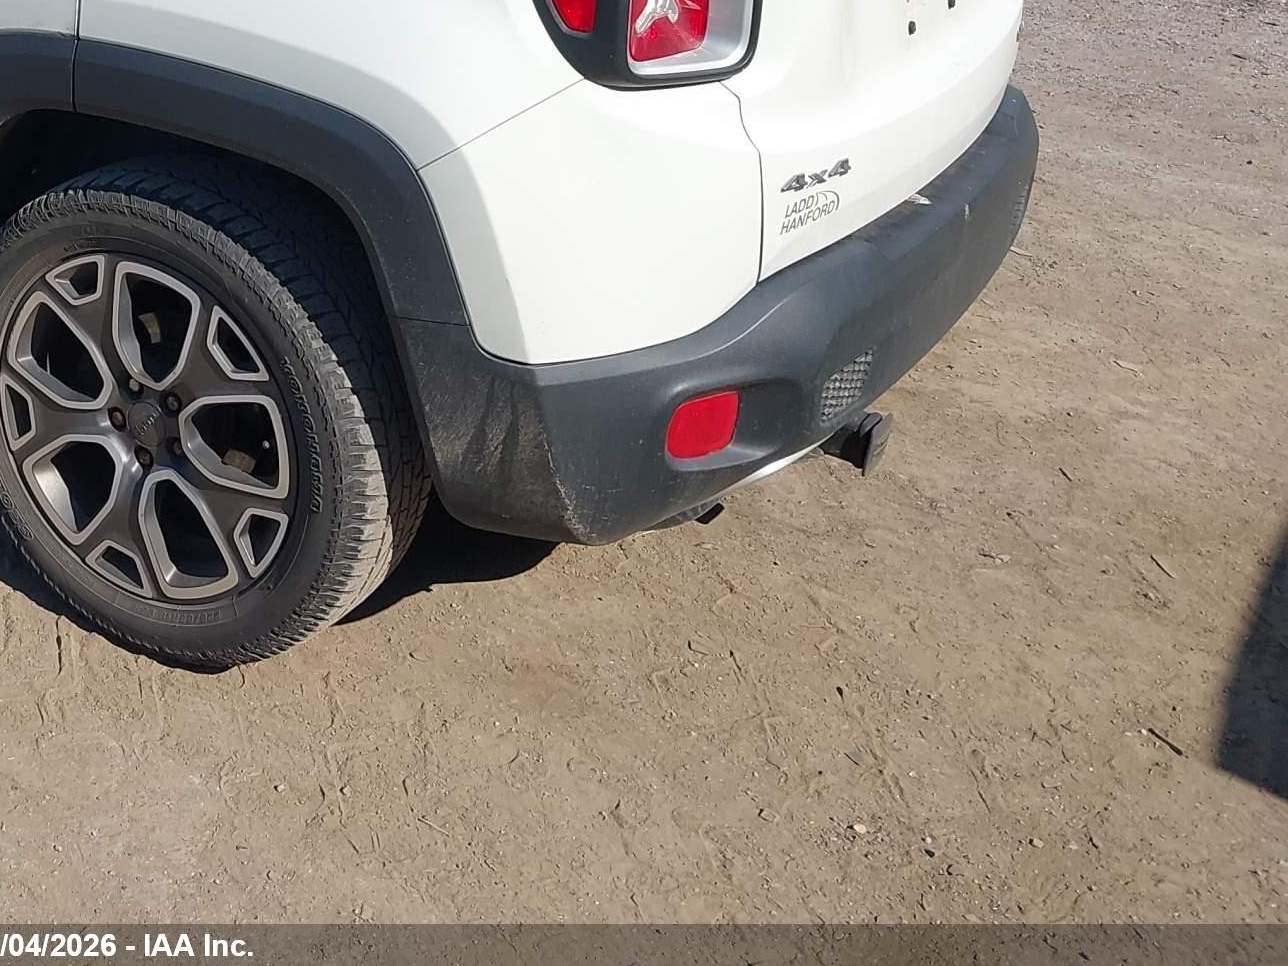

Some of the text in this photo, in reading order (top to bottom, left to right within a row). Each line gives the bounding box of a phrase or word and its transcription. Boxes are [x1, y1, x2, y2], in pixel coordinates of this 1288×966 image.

[780, 157, 852, 194] 4x4
[779, 200, 836, 235] HANFORD
[784, 194, 815, 219] LADD
[280, 355, 324, 513] YOKOHAMA
